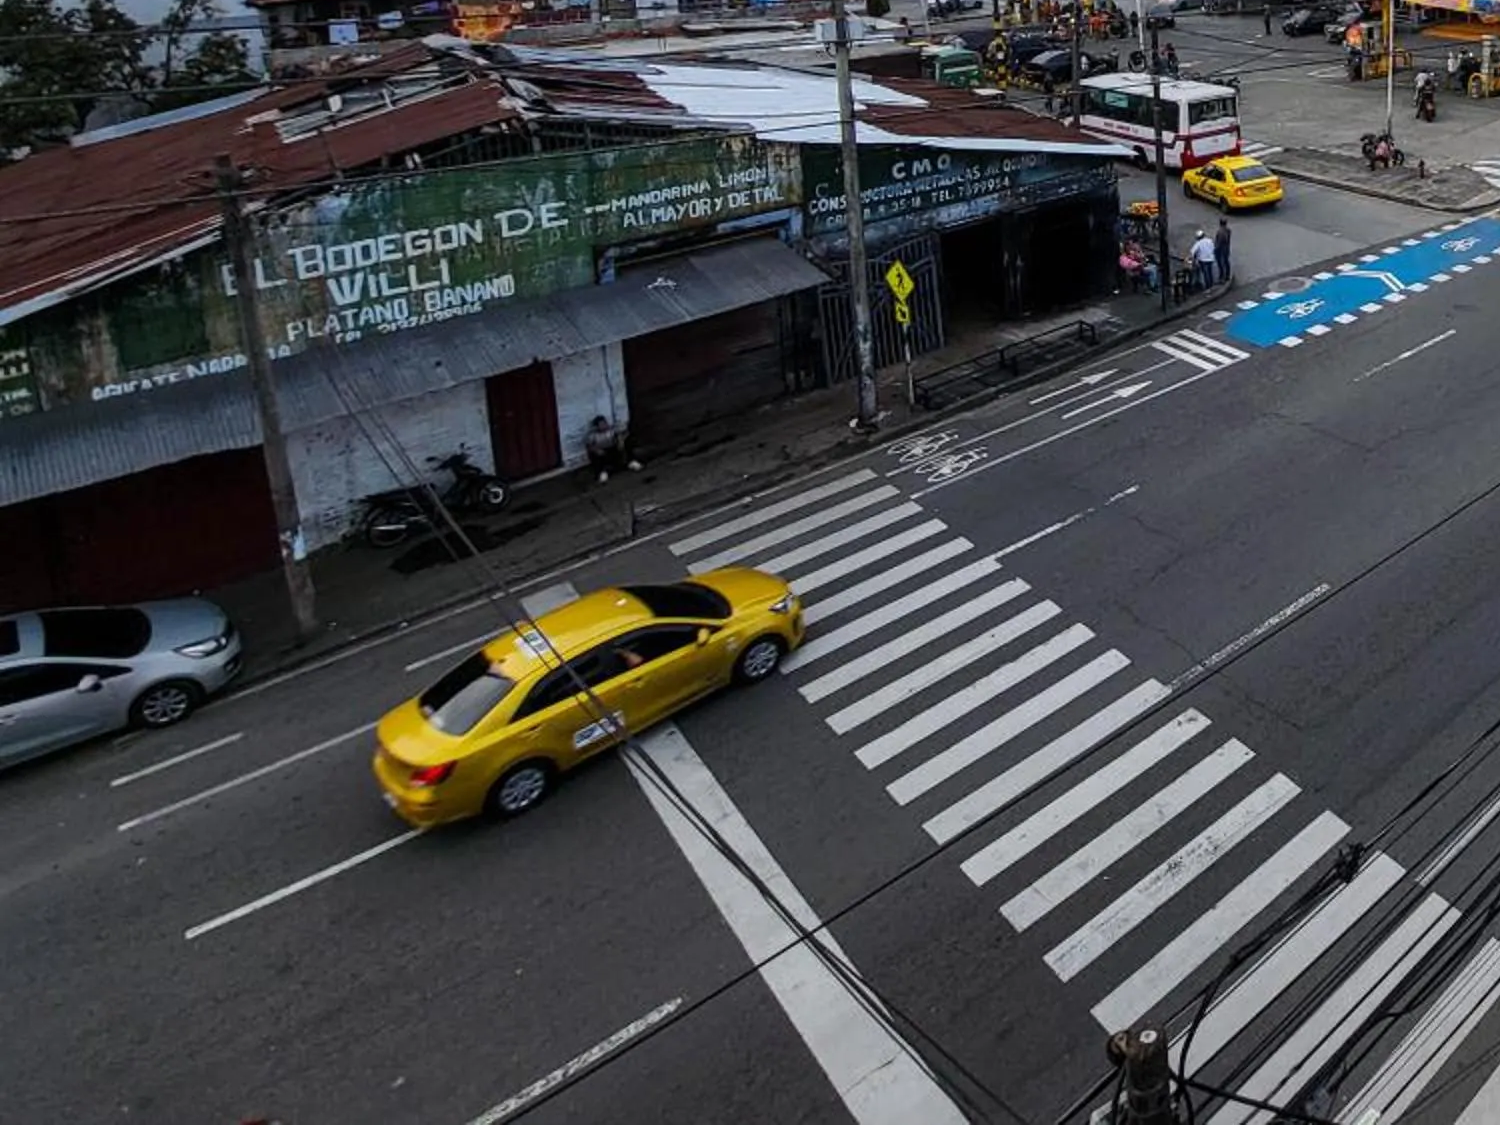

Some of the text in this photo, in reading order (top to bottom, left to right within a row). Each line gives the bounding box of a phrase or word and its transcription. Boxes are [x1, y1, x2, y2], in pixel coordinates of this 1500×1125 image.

[611, 166, 767, 212] MANDARINA LIMON
[623, 212, 647, 228] AL
[651, 198, 712, 224] MAYOR
[727, 183, 785, 209] DETAL
[287, 218, 483, 281] BODEGON
[494, 200, 569, 238] DE
[327, 257, 450, 306] WILLI
[286, 297, 410, 342] PLATANO
[424, 273, 515, 312] BANANO
